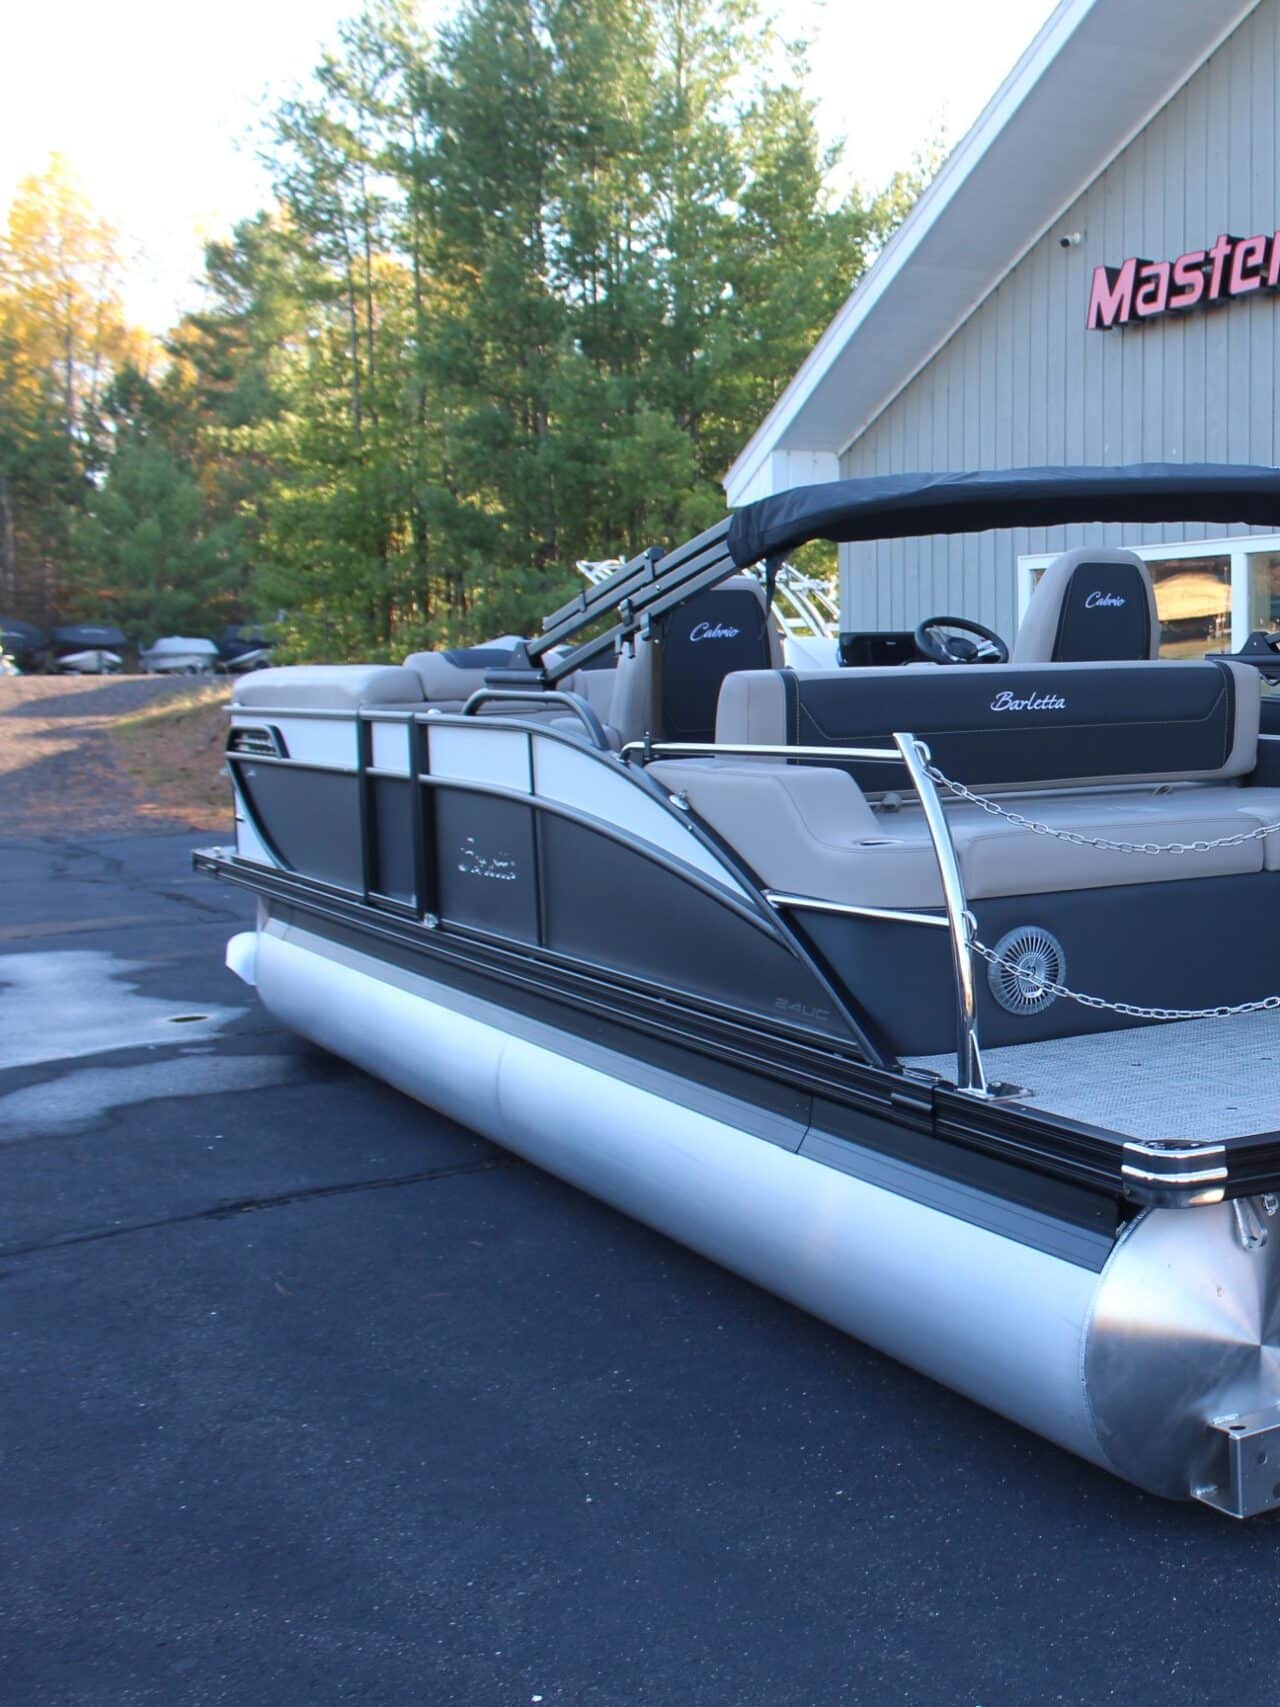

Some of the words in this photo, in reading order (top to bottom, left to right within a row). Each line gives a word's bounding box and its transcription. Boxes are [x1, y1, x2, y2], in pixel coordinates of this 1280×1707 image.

[1085, 591, 1125, 608] Cabrio
[690, 622, 739, 641] Cabrio
[990, 691, 1066, 711] Barletta
